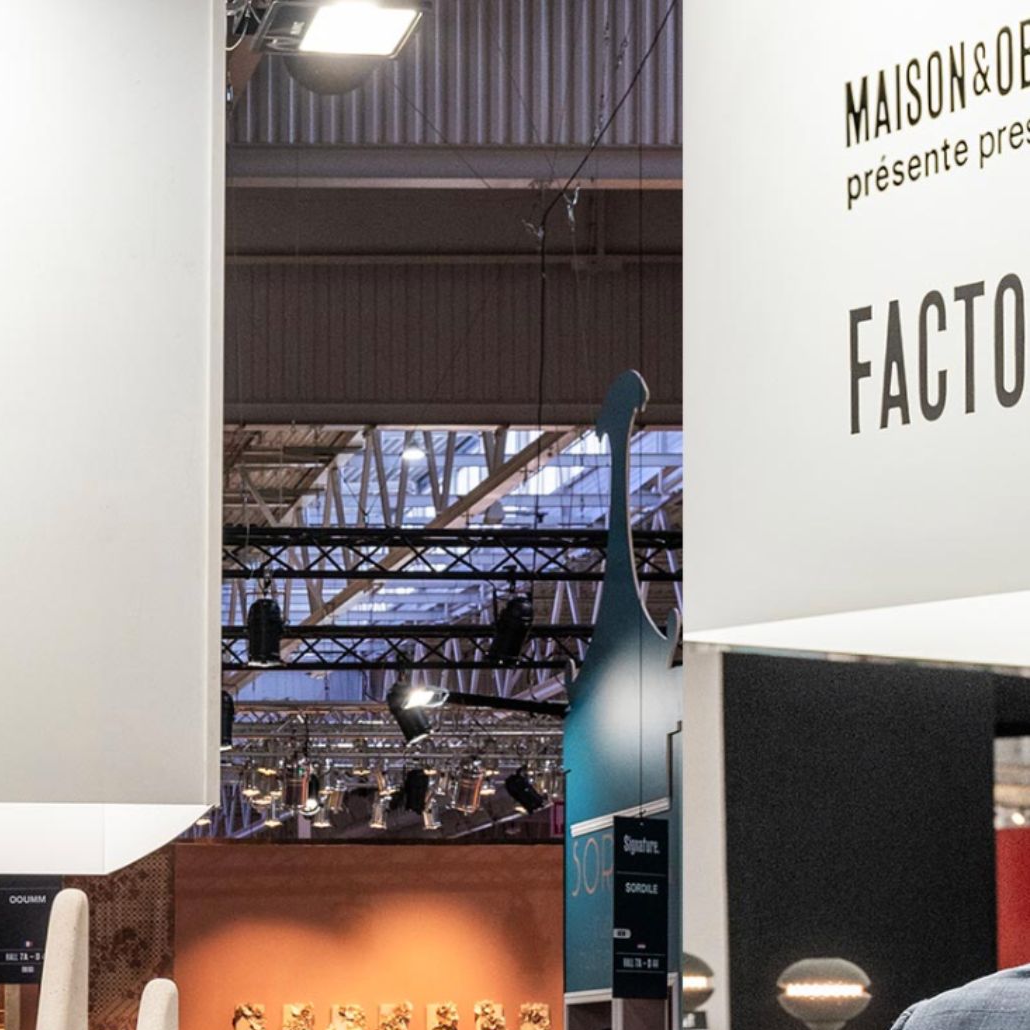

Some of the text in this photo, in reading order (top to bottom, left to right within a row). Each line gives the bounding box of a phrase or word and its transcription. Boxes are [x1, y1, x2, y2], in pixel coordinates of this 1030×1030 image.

[846, 137, 969, 211] présente
[848, 272, 1026, 436] FACTO
[9, 895, 46, 904] OOUMM
[625, 882, 659, 894] SORDILE
